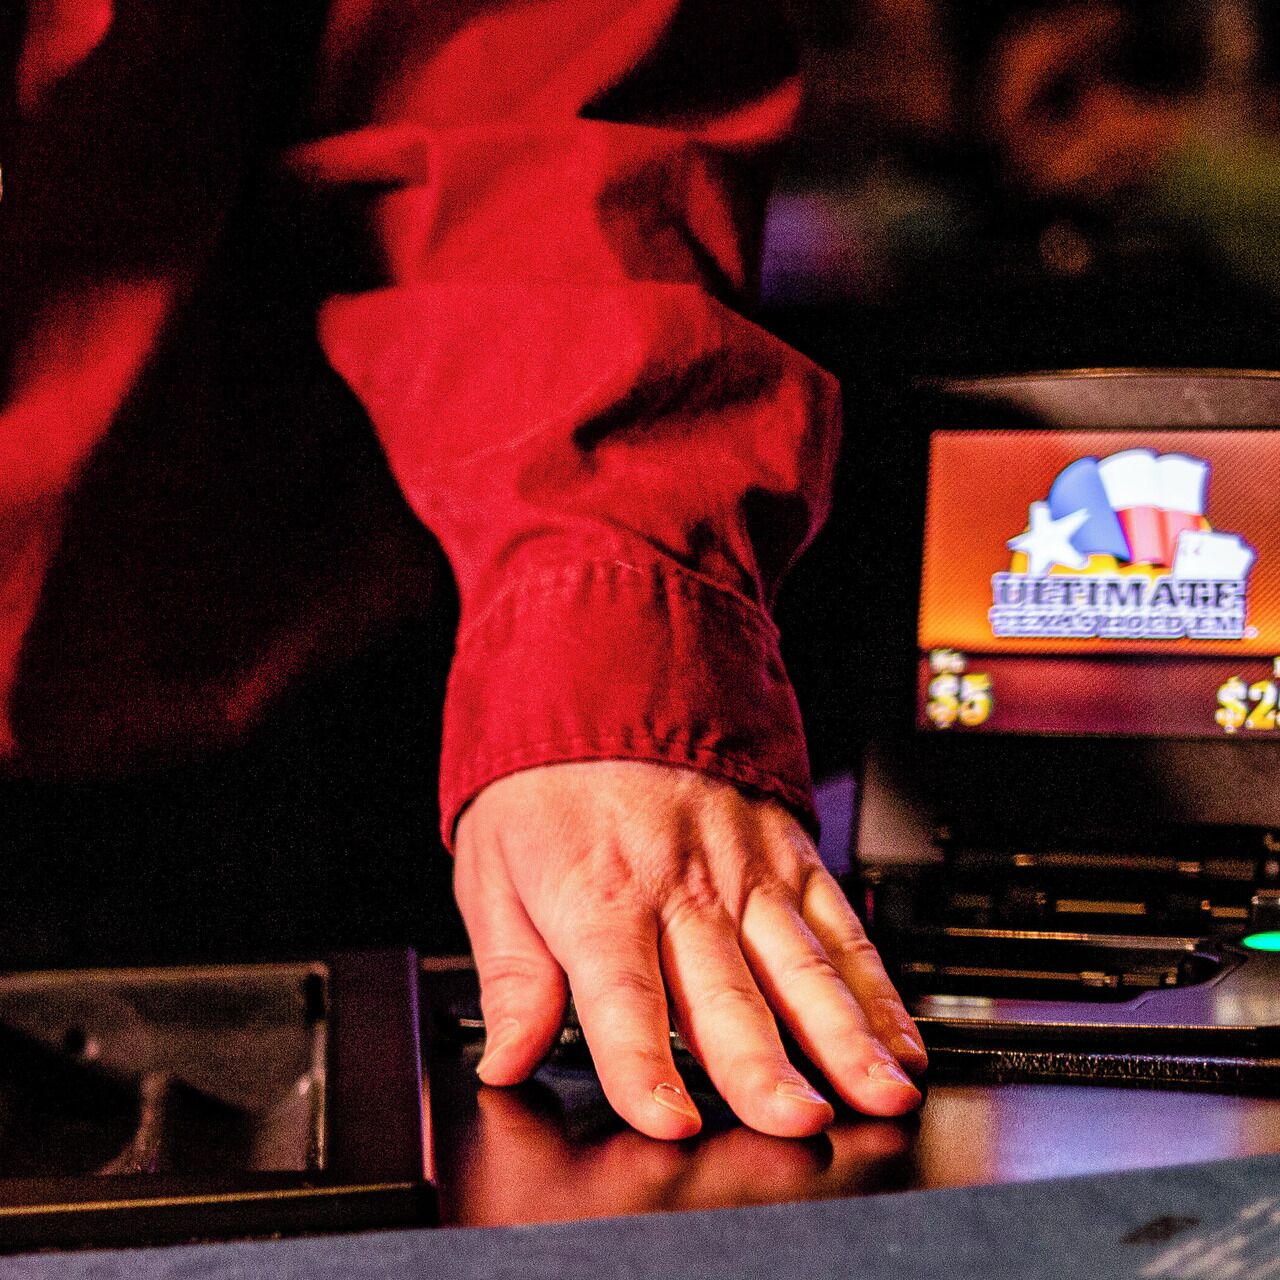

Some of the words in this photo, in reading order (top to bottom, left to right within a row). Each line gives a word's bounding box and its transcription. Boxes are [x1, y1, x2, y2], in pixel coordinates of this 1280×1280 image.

[999, 581, 1240, 608] ULTIMATE
[927, 673, 993, 729] $5
[1215, 675, 1280, 734] $2
